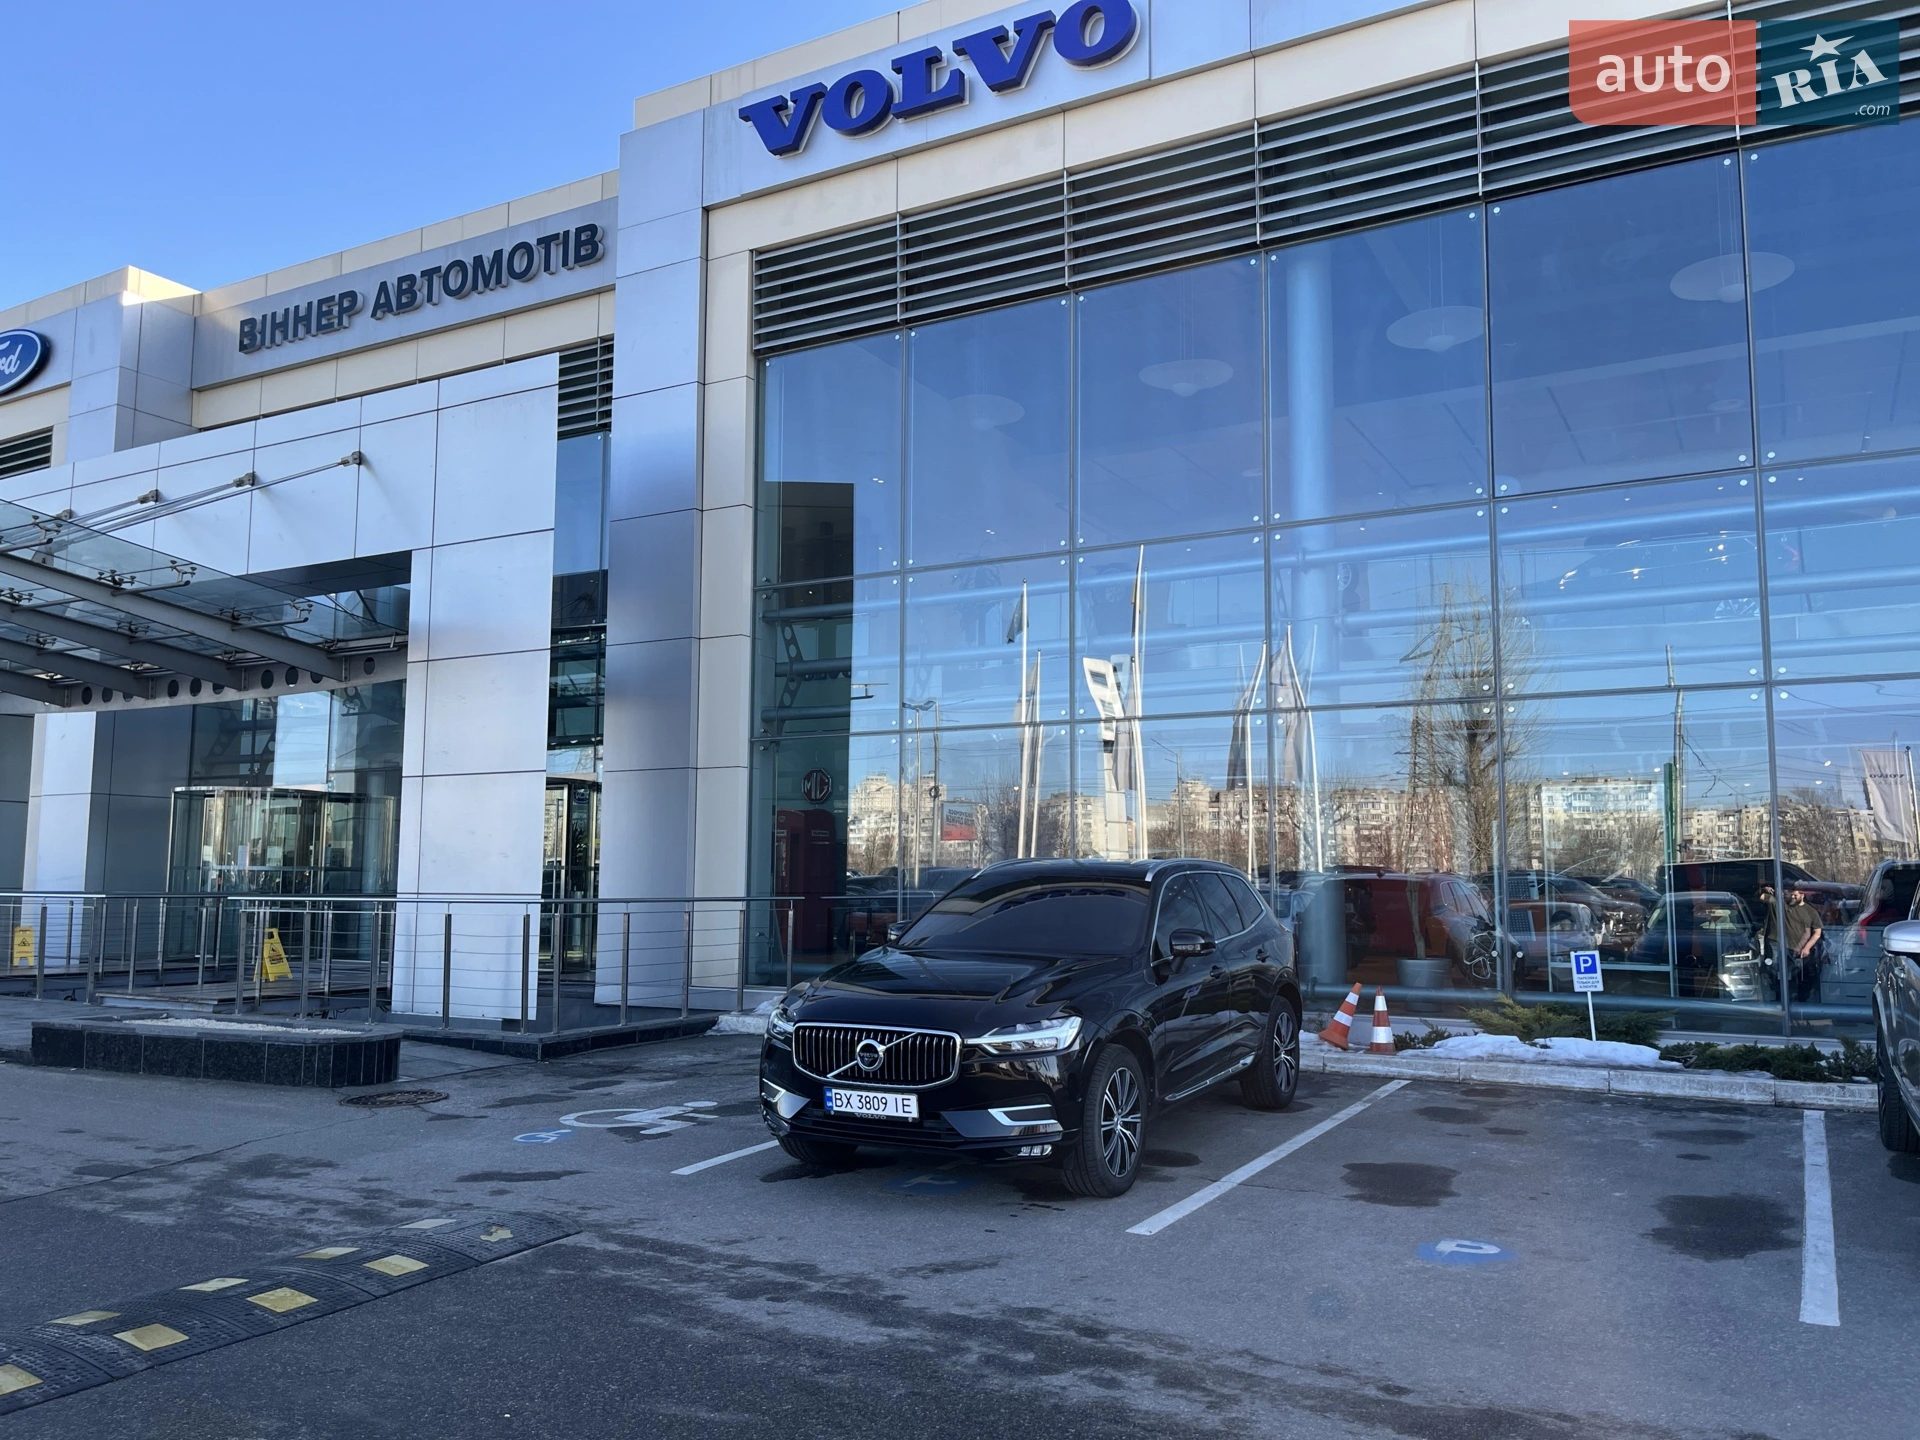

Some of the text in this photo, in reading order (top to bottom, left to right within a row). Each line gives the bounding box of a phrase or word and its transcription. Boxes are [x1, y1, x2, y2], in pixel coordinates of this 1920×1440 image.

[738, 0, 1138, 157] VOLVO
[239, 223, 602, 354] ВІННЕР АВТОМОТІВ
[804, 772, 829, 800] MG
[1580, 956, 1592, 973] P
[834, 1092, 912, 1114] BX 3809 IE
